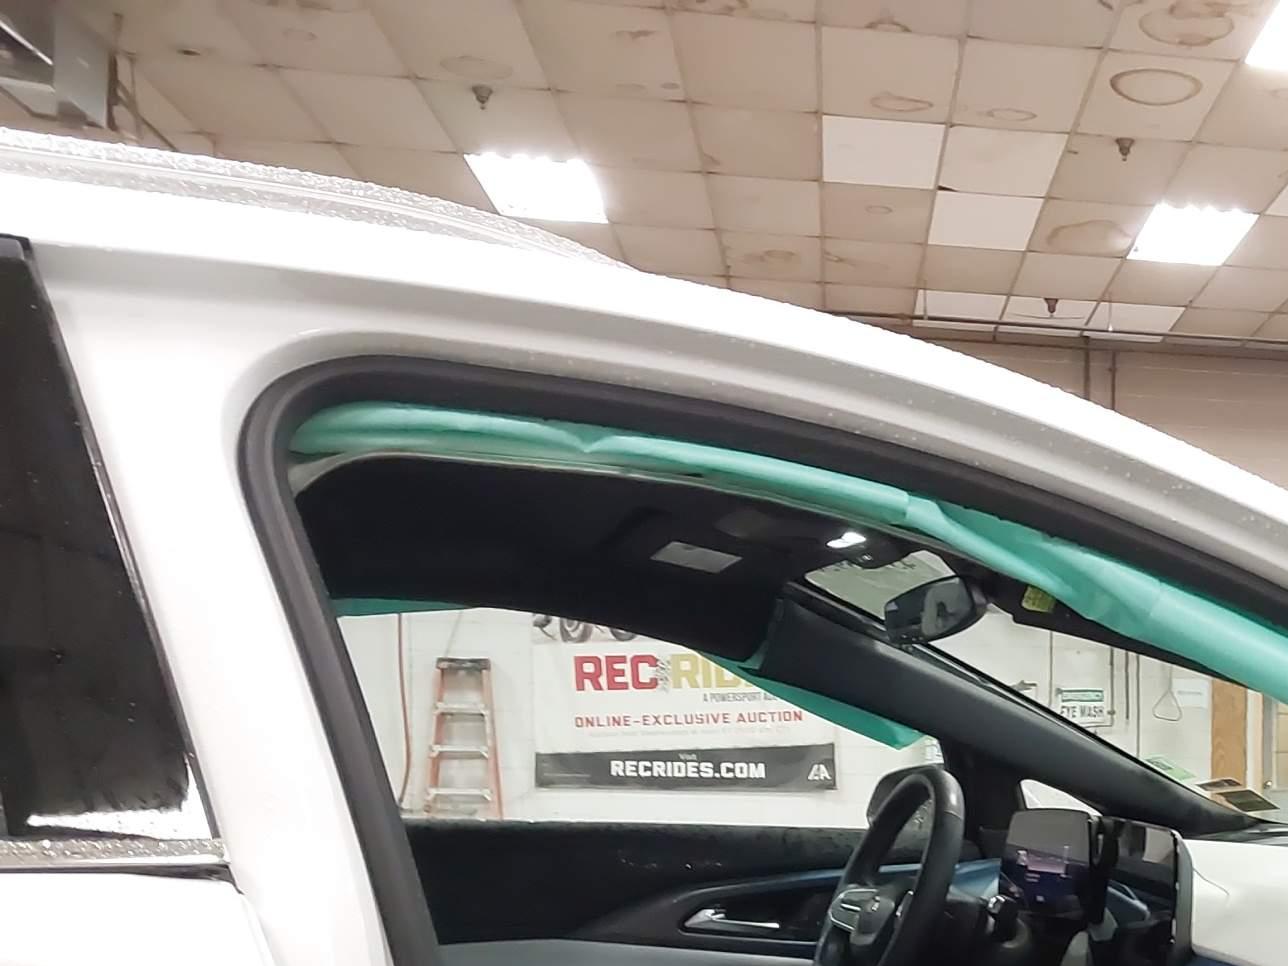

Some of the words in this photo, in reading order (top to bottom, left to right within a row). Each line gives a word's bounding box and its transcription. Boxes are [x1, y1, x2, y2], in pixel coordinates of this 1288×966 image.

[574, 655, 658, 691] REC
[575, 712, 730, 728] ONLINE-EXCLUSIVE
[736, 710, 803, 723] AUCTION
[610, 760, 766, 779] RECRIDES.COM
